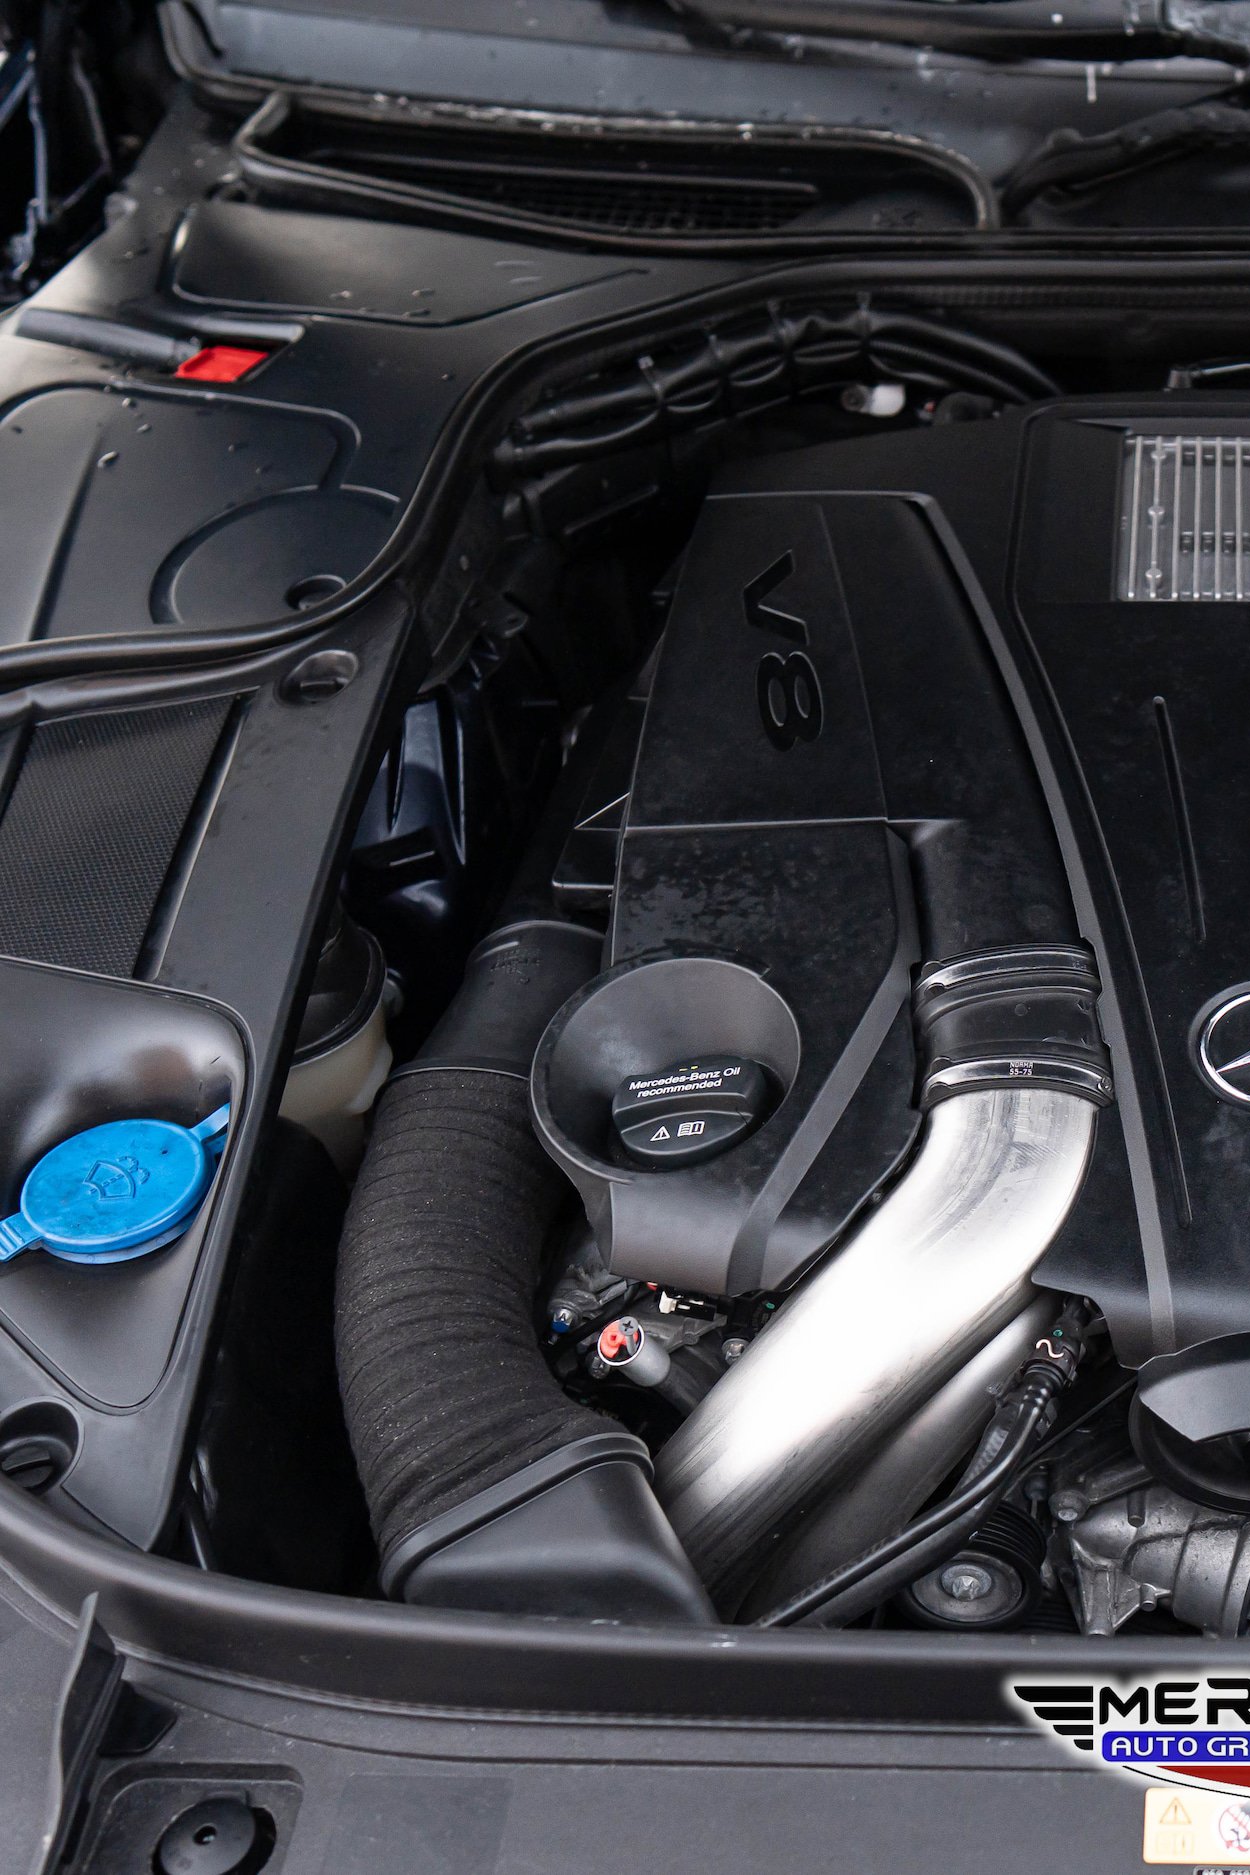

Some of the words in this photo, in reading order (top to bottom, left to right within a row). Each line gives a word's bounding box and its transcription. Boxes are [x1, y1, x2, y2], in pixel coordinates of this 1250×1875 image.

[743, 549, 824, 752] V8
[629, 1070, 721, 1091] Mercedes-Benz
[723, 1067, 741, 1077] Oil
[637, 1078, 722, 1098] recommended
